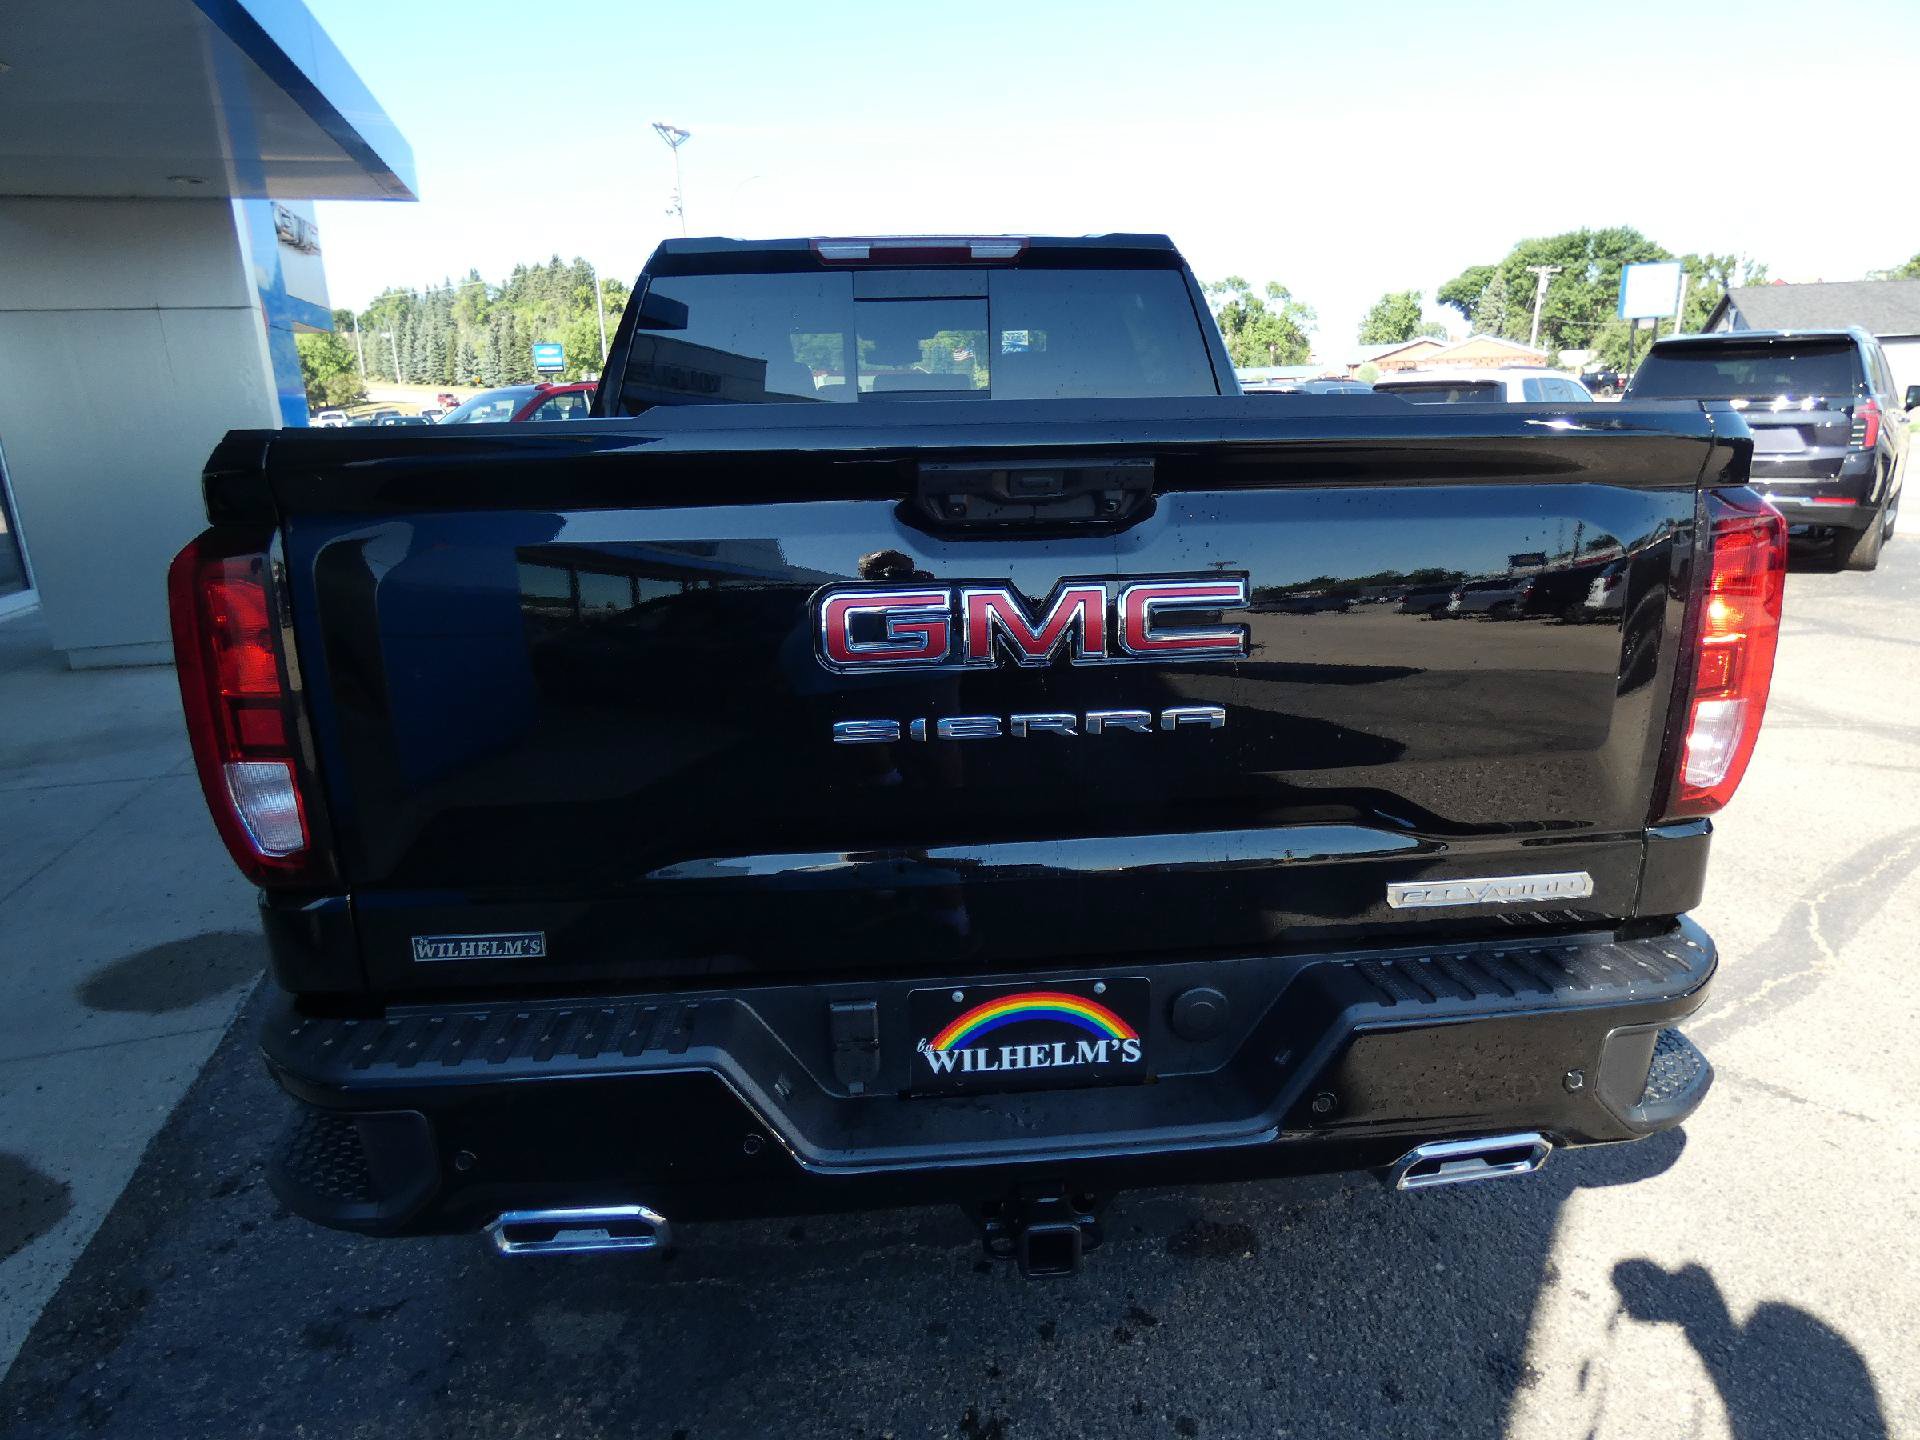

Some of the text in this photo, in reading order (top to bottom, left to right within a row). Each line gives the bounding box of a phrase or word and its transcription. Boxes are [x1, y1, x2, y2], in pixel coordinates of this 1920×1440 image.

[816, 575, 1250, 670] GMC
[832, 705, 1227, 744] SIERRA
[416, 938, 541, 958] WILHELM'S
[916, 1037, 935, 1055] by
[924, 1037, 1142, 1075] WILHELM'S
